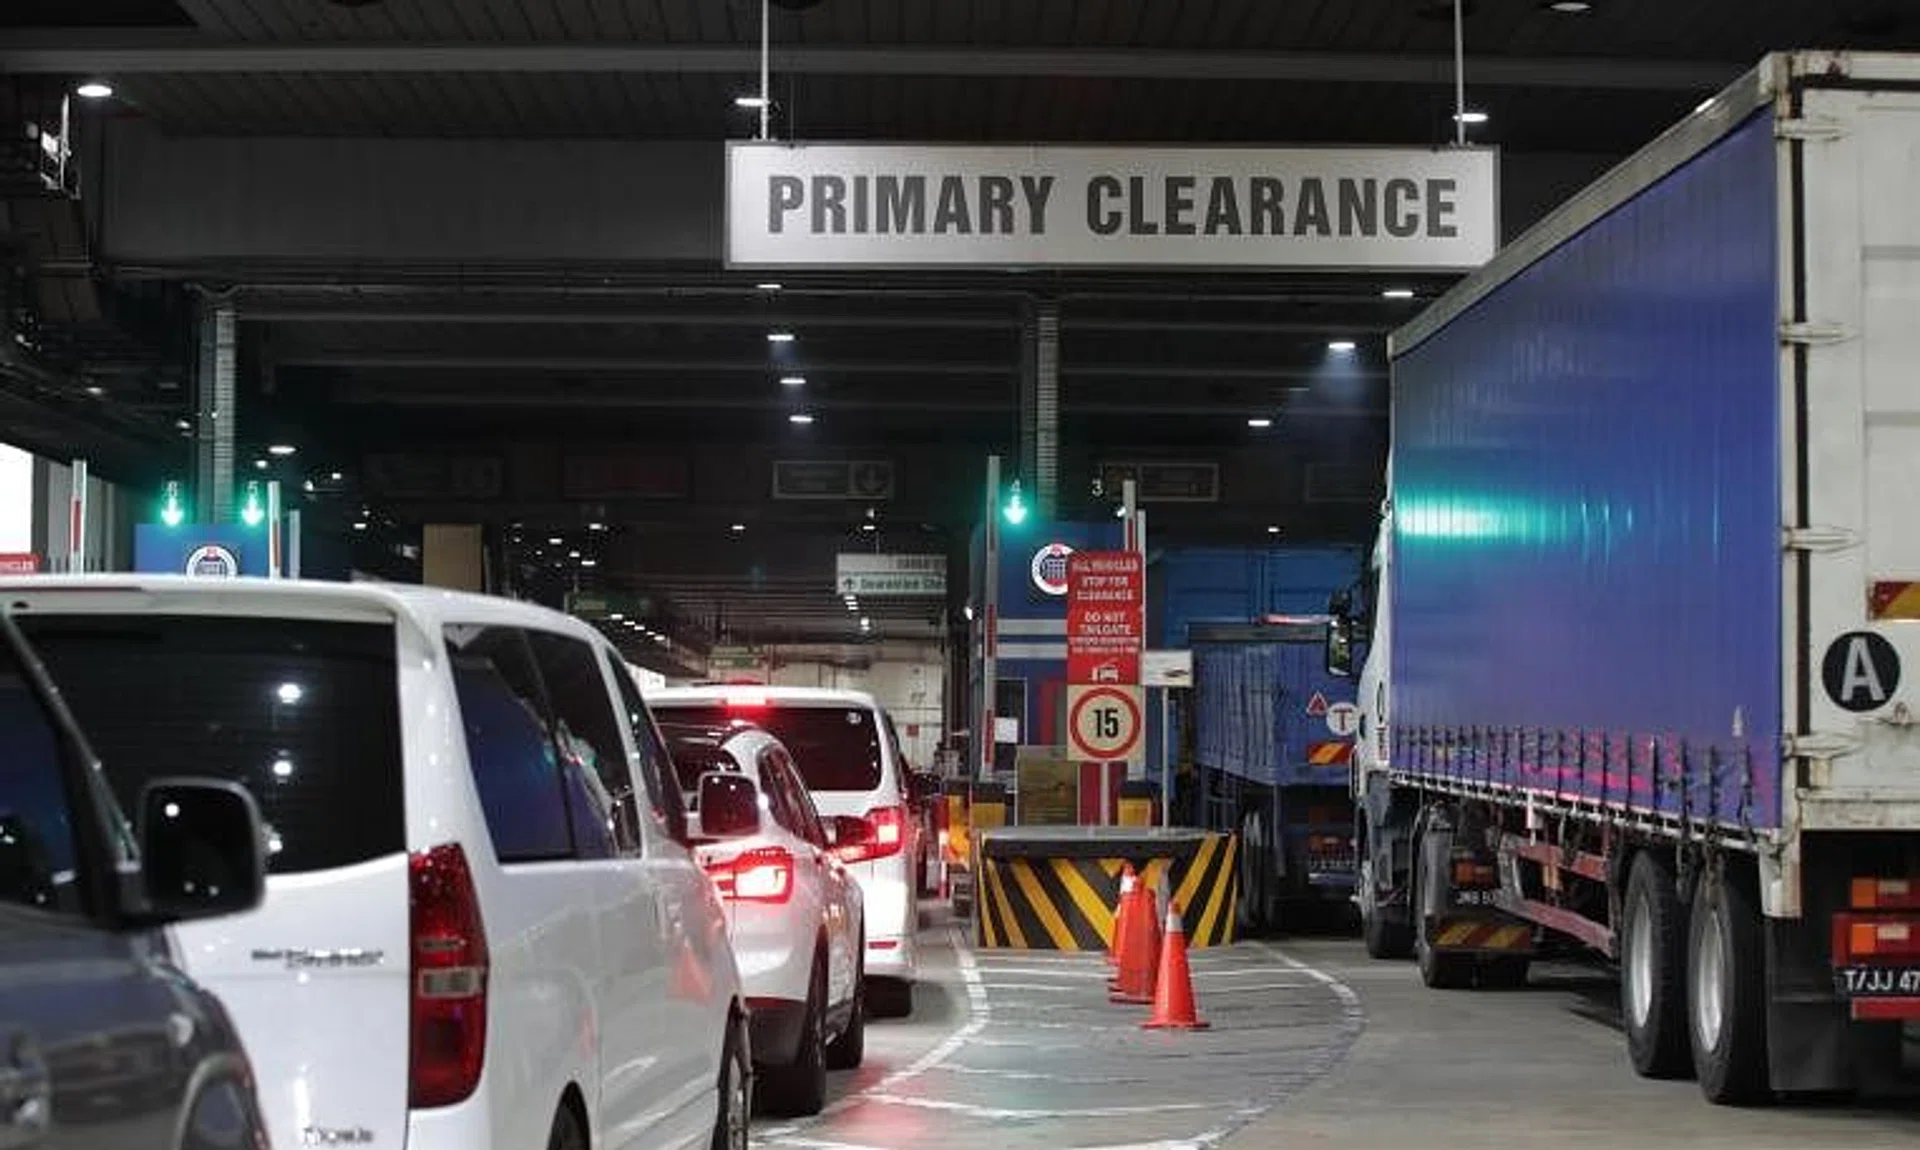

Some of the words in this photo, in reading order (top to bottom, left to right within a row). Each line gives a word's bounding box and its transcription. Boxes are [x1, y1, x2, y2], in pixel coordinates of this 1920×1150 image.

[768, 175, 1055, 235] PRIMARY
[1087, 176, 1458, 238] CLEARANCE
[1091, 478, 1104, 497] 3
[1084, 611, 1101, 622] DO
[1102, 611, 1126, 622] NOT
[1078, 623, 1132, 635] TAILGATE
[1841, 637, 1887, 701] A
[1093, 707, 1119, 738] 15
[1332, 708, 1353, 732] T
[1843, 970, 1894, 993] T/JJ
